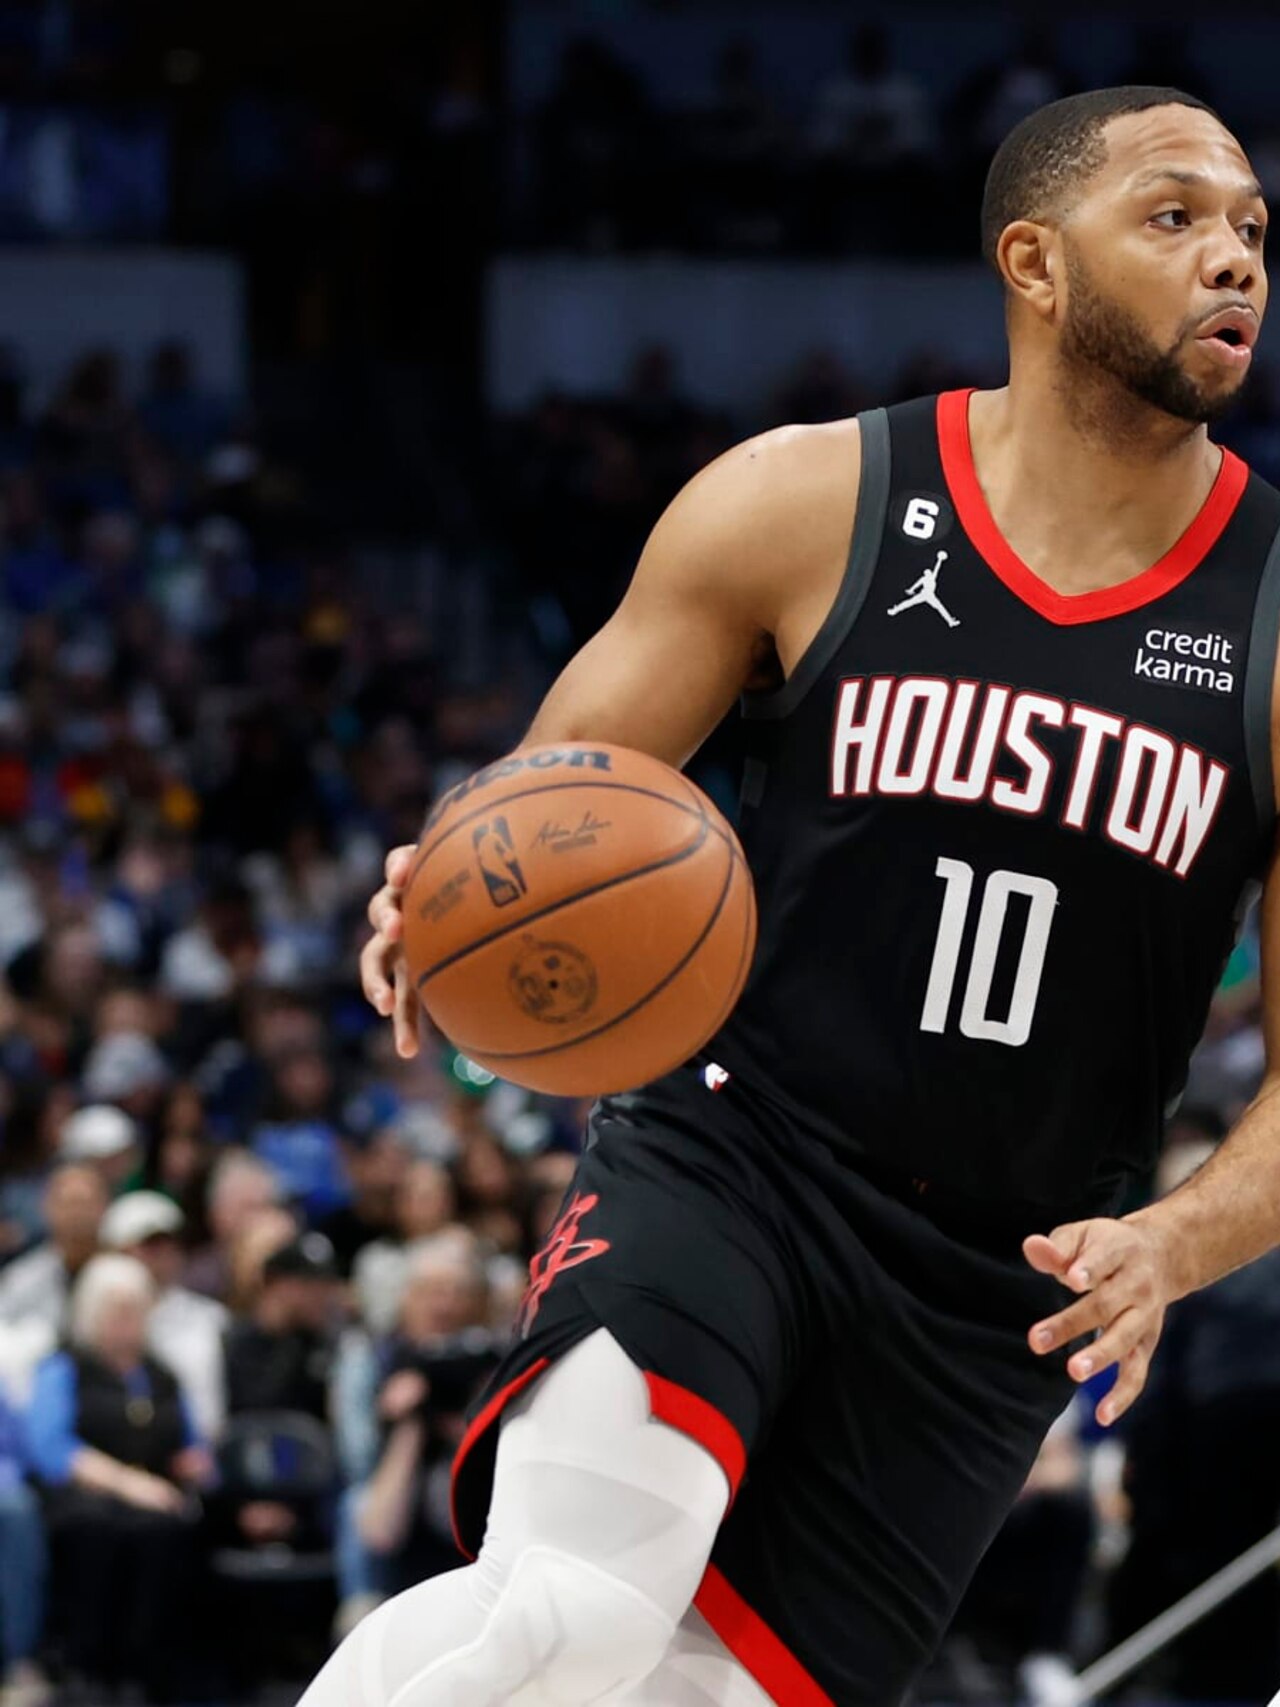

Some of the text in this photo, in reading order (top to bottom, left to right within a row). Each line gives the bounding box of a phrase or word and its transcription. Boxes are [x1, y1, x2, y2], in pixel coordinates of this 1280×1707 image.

[902, 497, 940, 540] 6
[1145, 628, 1234, 664] credit
[1134, 648, 1235, 694] karma
[830, 674, 1230, 879] HOUSTON
[919, 856, 1059, 1047] 10
